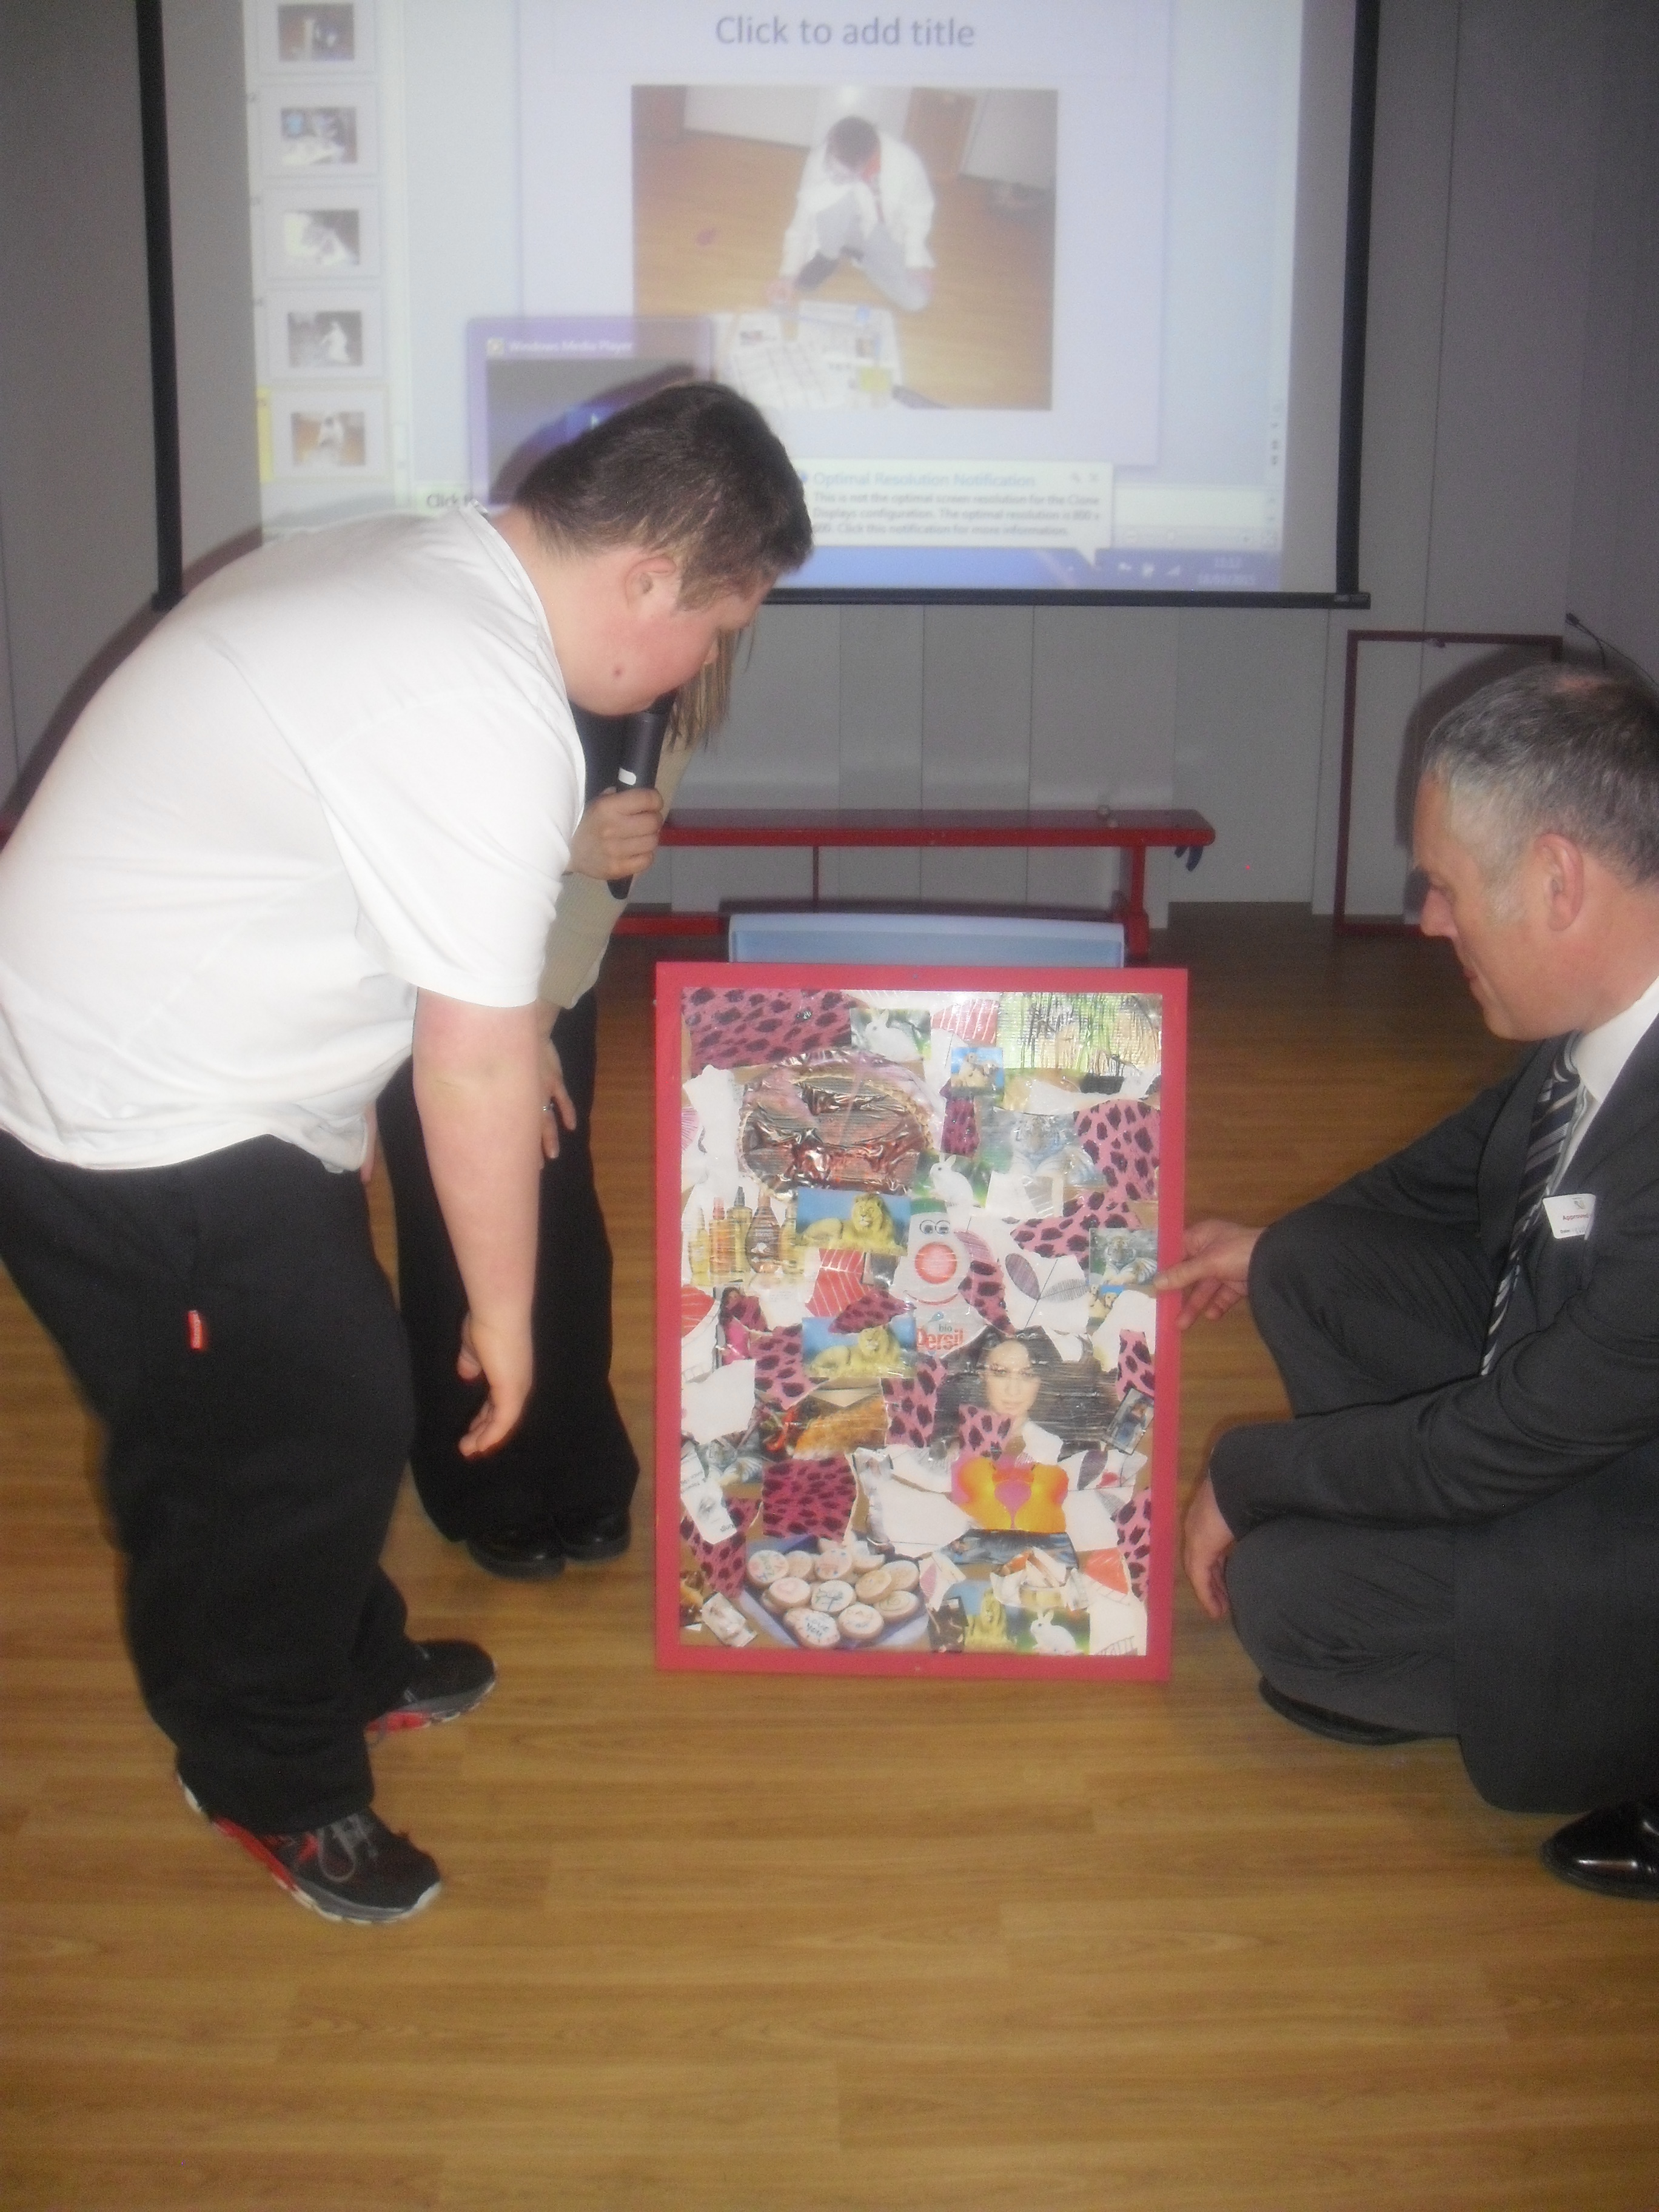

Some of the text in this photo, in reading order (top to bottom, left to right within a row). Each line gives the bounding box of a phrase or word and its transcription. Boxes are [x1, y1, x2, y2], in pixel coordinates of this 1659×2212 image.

[716, 16, 976, 47] Click to add title
[509, 340, 633, 355] Windows Media Player
[814, 471, 1035, 488] Optimal Resolution Notification
[939, 1323, 953, 1332] bio
